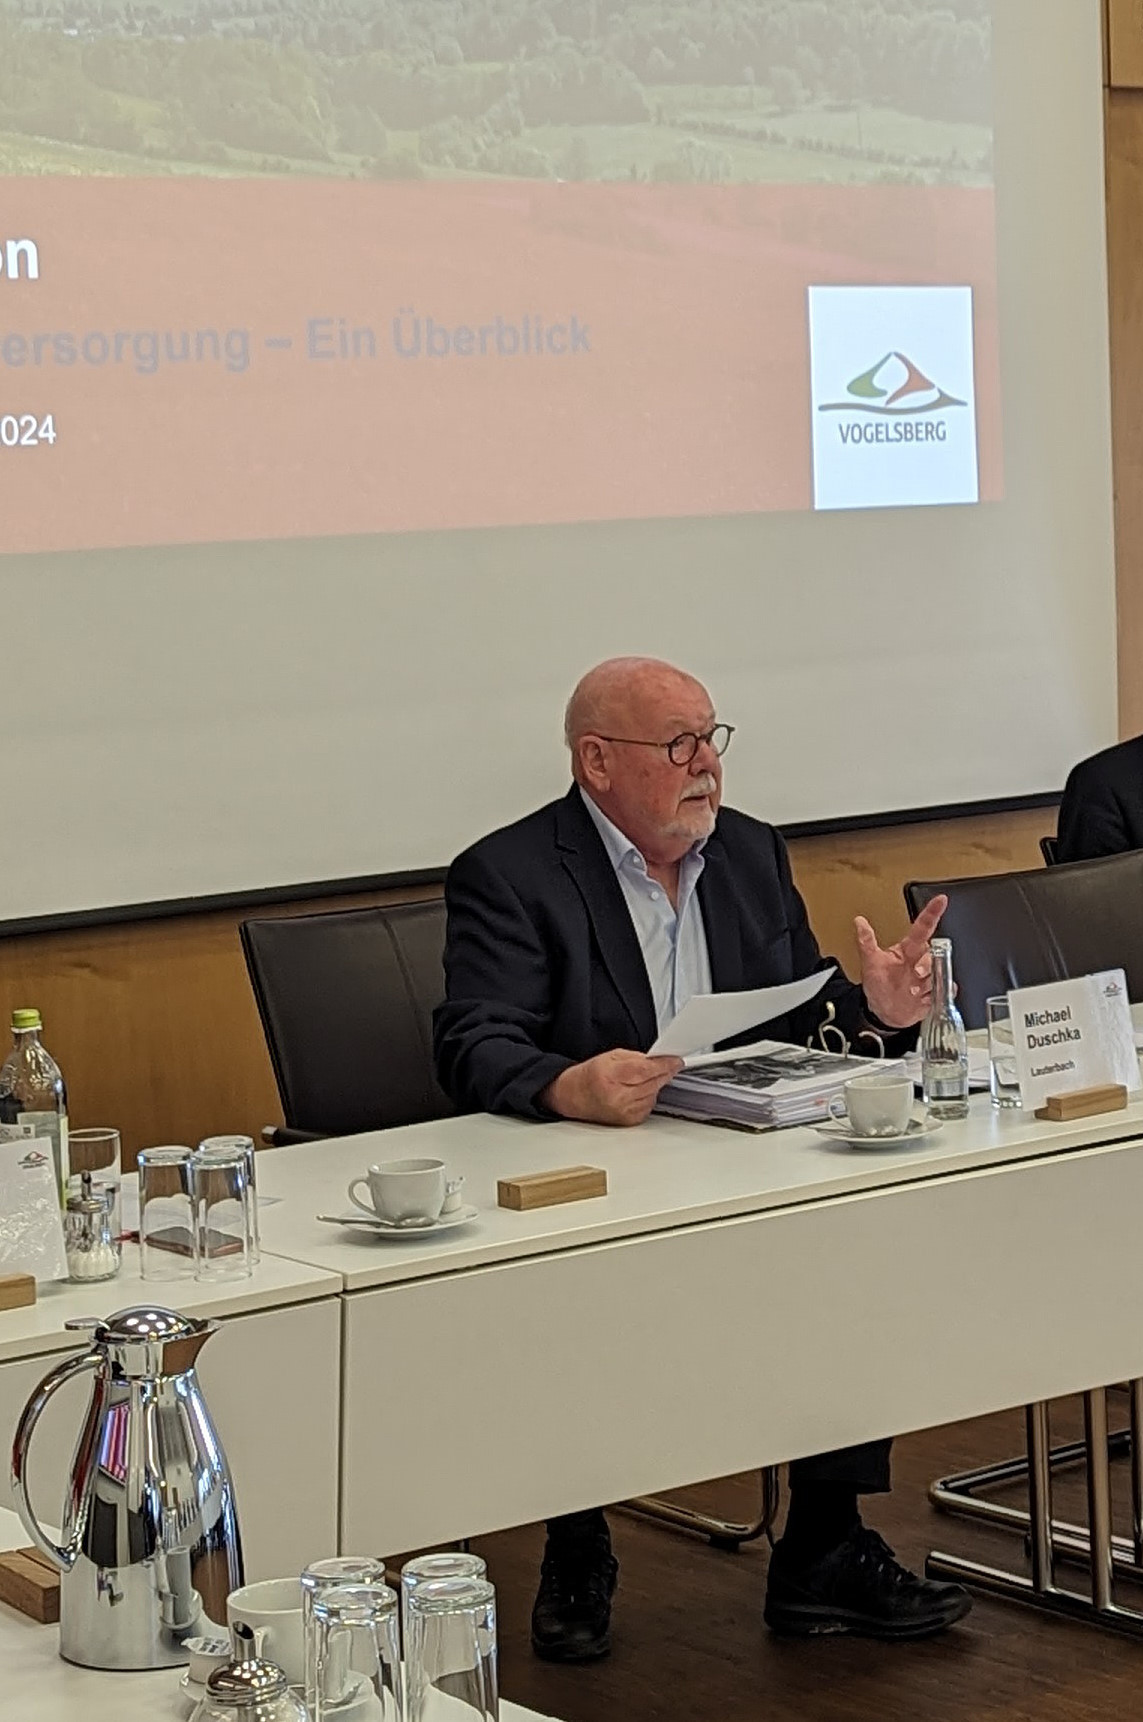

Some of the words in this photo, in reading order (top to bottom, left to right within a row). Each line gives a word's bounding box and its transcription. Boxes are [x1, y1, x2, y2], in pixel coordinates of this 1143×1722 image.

[0, 238, 39, 280] n
[307, 317, 377, 359] Ein
[393, 308, 591, 359] Überblick
[838, 421, 947, 444] VOGELSBERG
[1024, 1006, 1072, 1027] Michael
[1027, 1028, 1081, 1049] Duschka
[1030, 1060, 1075, 1077] Lauterbach
